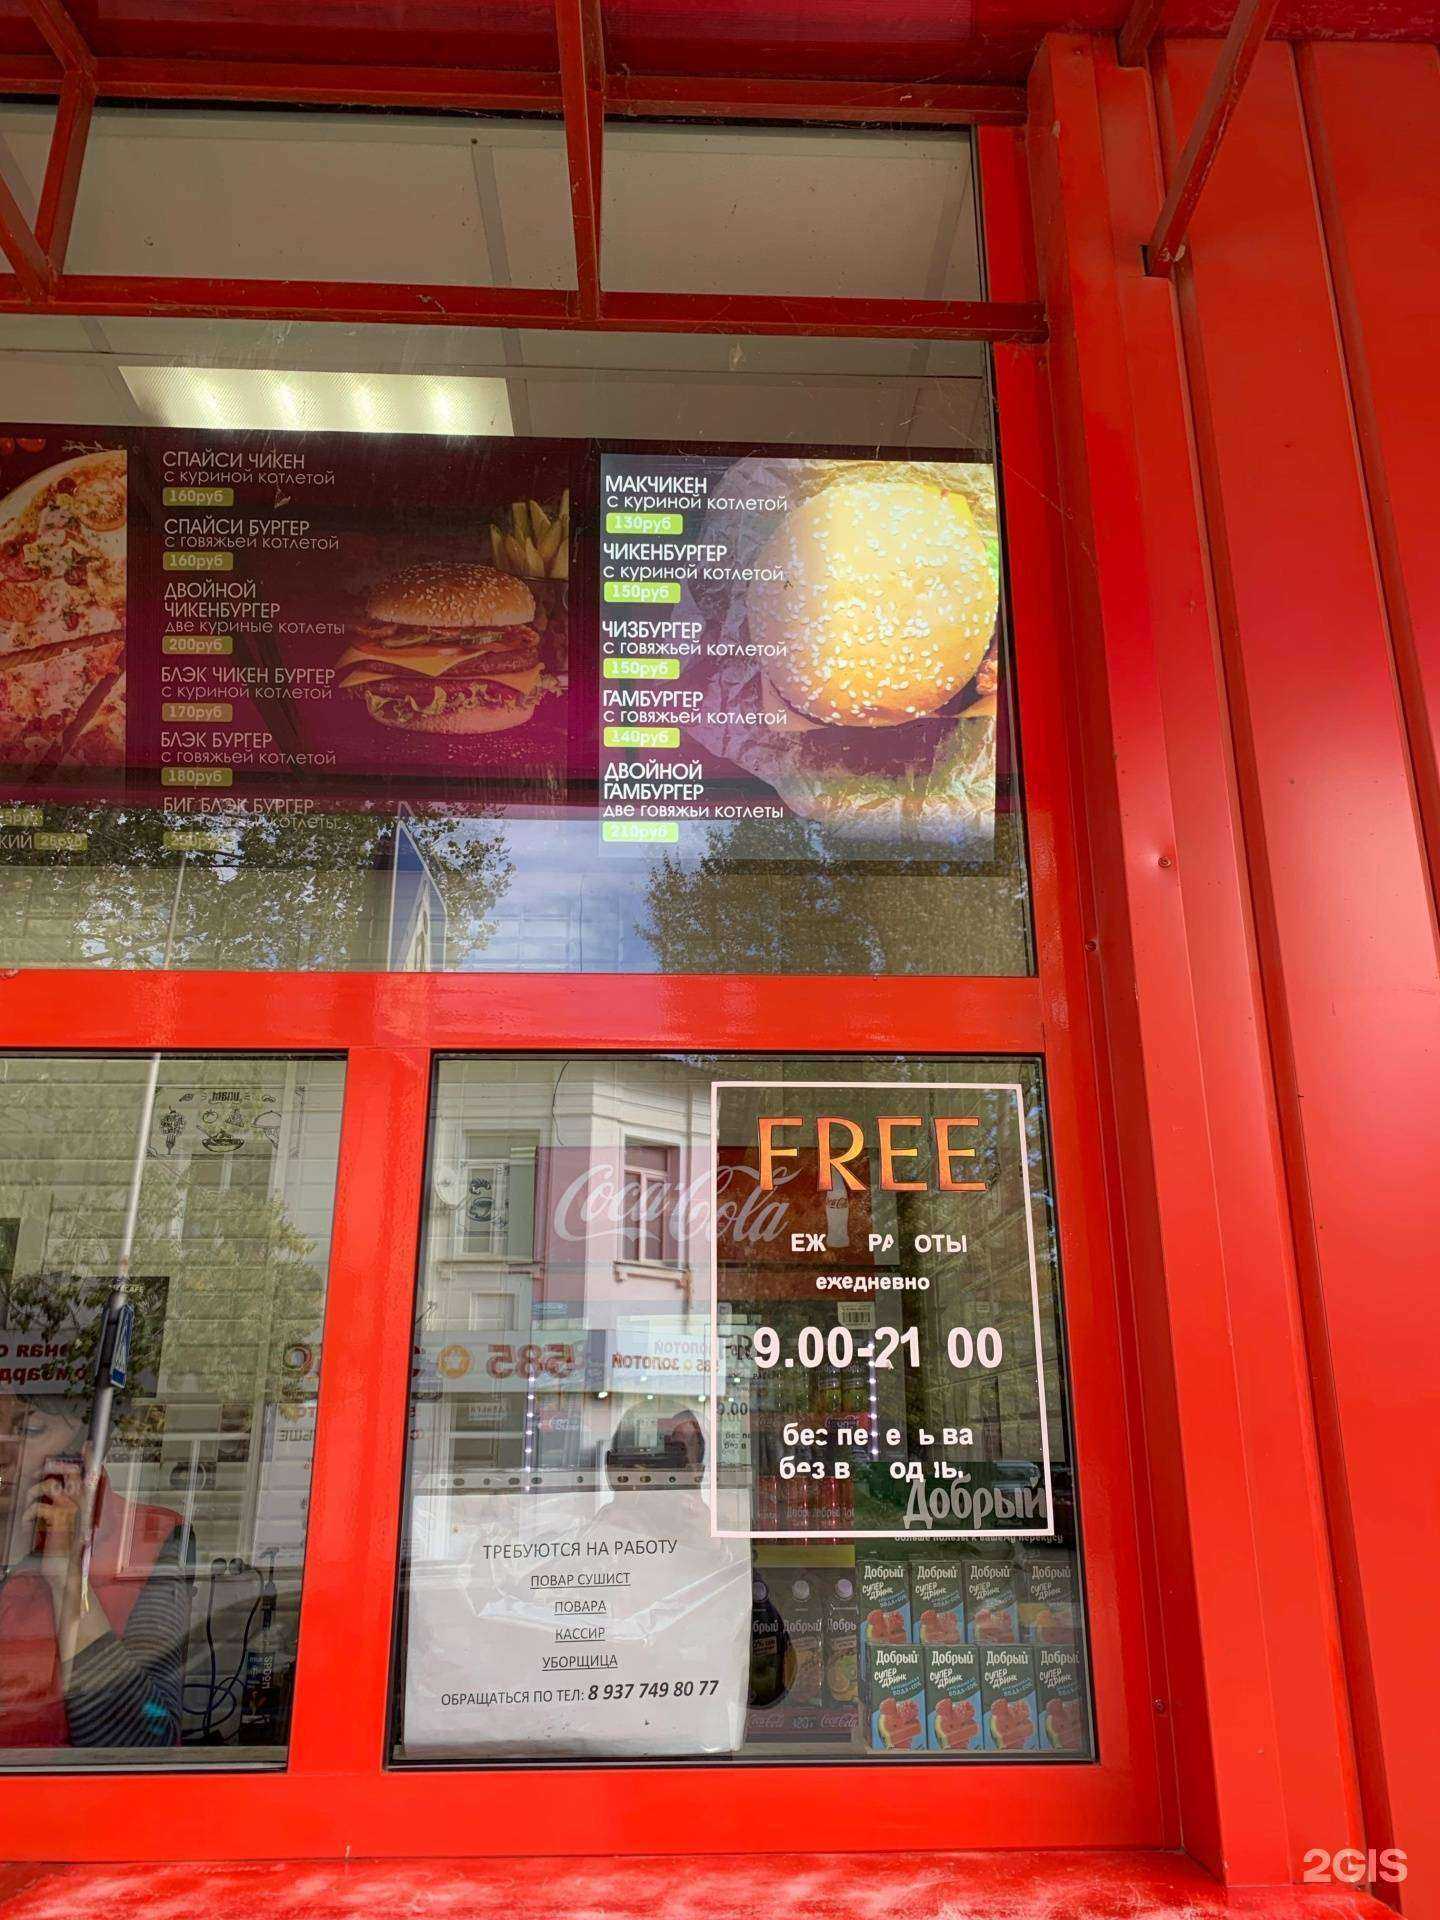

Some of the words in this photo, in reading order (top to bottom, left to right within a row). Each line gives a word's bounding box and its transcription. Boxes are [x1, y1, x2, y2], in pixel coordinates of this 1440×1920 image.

[163, 448, 243, 469] СПАЙСИ
[248, 453, 304, 469] ЧИКЕН
[178, 468, 252, 486] куриной
[259, 470, 335, 485] котлетой
[606, 475, 707, 494] МАКЧИКЕН
[169, 489, 223, 503] 160руб
[624, 493, 701, 511] куриной
[708, 495, 787, 512] котлетой
[164, 516, 243, 535] СПАЙСИ
[250, 519, 309, 536] БУРГЕР
[614, 515, 671, 531] 130руб
[181, 534, 256, 548] говяжьей
[263, 535, 339, 551] котлетой
[604, 543, 727, 561] ЧИКЕНБУРГЕР
[169, 555, 223, 569] 160руб
[620, 564, 698, 581] куриной
[704, 565, 783, 582] котлетой
[164, 579, 256, 600] ДВОЙНОЙ
[612, 585, 669, 601] 150руб
[164, 601, 280, 619] ЧИКЕНБУРГЕР
[165, 620, 194, 634] две
[200, 621, 273, 635] куриные
[279, 622, 344, 635] котлеты
[603, 621, 702, 639] ЧИЗБУРГЕР
[169, 637, 223, 653] 200руб
[620, 640, 701, 656] говяжьей
[708, 641, 787, 657] котлетой
[161, 667, 208, 684] БЛЭК
[212, 667, 269, 684] ЧИКЕН
[275, 668, 335, 685] БУРГЕР
[612, 661, 668, 676] 150руб
[176, 683, 249, 700] куриной
[256, 684, 333, 700] котлетой
[603, 690, 703, 707] ГАМБУРГЕР
[169, 705, 222, 720] 170руб
[621, 709, 701, 723] говяжьей
[708, 710, 787, 725] котлетой
[161, 732, 209, 748] БЛЭК
[213, 732, 272, 748] БУРГЕР
[611, 730, 669, 746] 140руб
[176, 748, 253, 764] говяжьей
[260, 749, 336, 765] котлетой
[169, 770, 222, 786] 180руб
[604, 759, 702, 782] ДВОЙНОЙ
[604, 783, 704, 800] ГАМБУРГЕР
[164, 797, 195, 812] БИГ
[202, 798, 250, 812] БЛЭК
[254, 799, 314, 814] БУРГЕР
[603, 805, 634, 817] две
[641, 805, 709, 817] говяжьи
[715, 806, 783, 818] котлеты
[758, 1116, 988, 1192] FREE
[816, 1276, 930, 1292] ежедневно
[484, 1543, 580, 1559] ТРЕБУЮТСЯ
[587, 1541, 609, 1556] НА
[614, 1539, 678, 1555] РАБОТУ
[531, 1574, 573, 1588] ПОВАР
[578, 1572, 631, 1585] СУШИСТ
[864, 1566, 904, 1579] Добрый
[918, 1566, 958, 1580] Добрый
[971, 1566, 1010, 1580] Добрый
[555, 1601, 607, 1613] ПОВАРА
[556, 1627, 605, 1640] КАССИР
[753, 1620, 778, 1634] брый
[542, 1655, 618, 1669] УБОРЩИЦА
[876, 1650, 918, 1666] Добрый
[932, 1651, 973, 1666] Добрый
[987, 1651, 1029, 1666] Добрый
[441, 1691, 529, 1706] ОБРАЩАТЬСЯ
[533, 1690, 552, 1703] ПО
[557, 1689, 584, 1702] ТЕЛ:
[588, 1685, 598, 1700] 8
[603, 1684, 634, 1699] 937
[639, 1682, 667, 1699] 749
[674, 1681, 694, 1697] 80
[699, 1680, 719, 1696] 77
